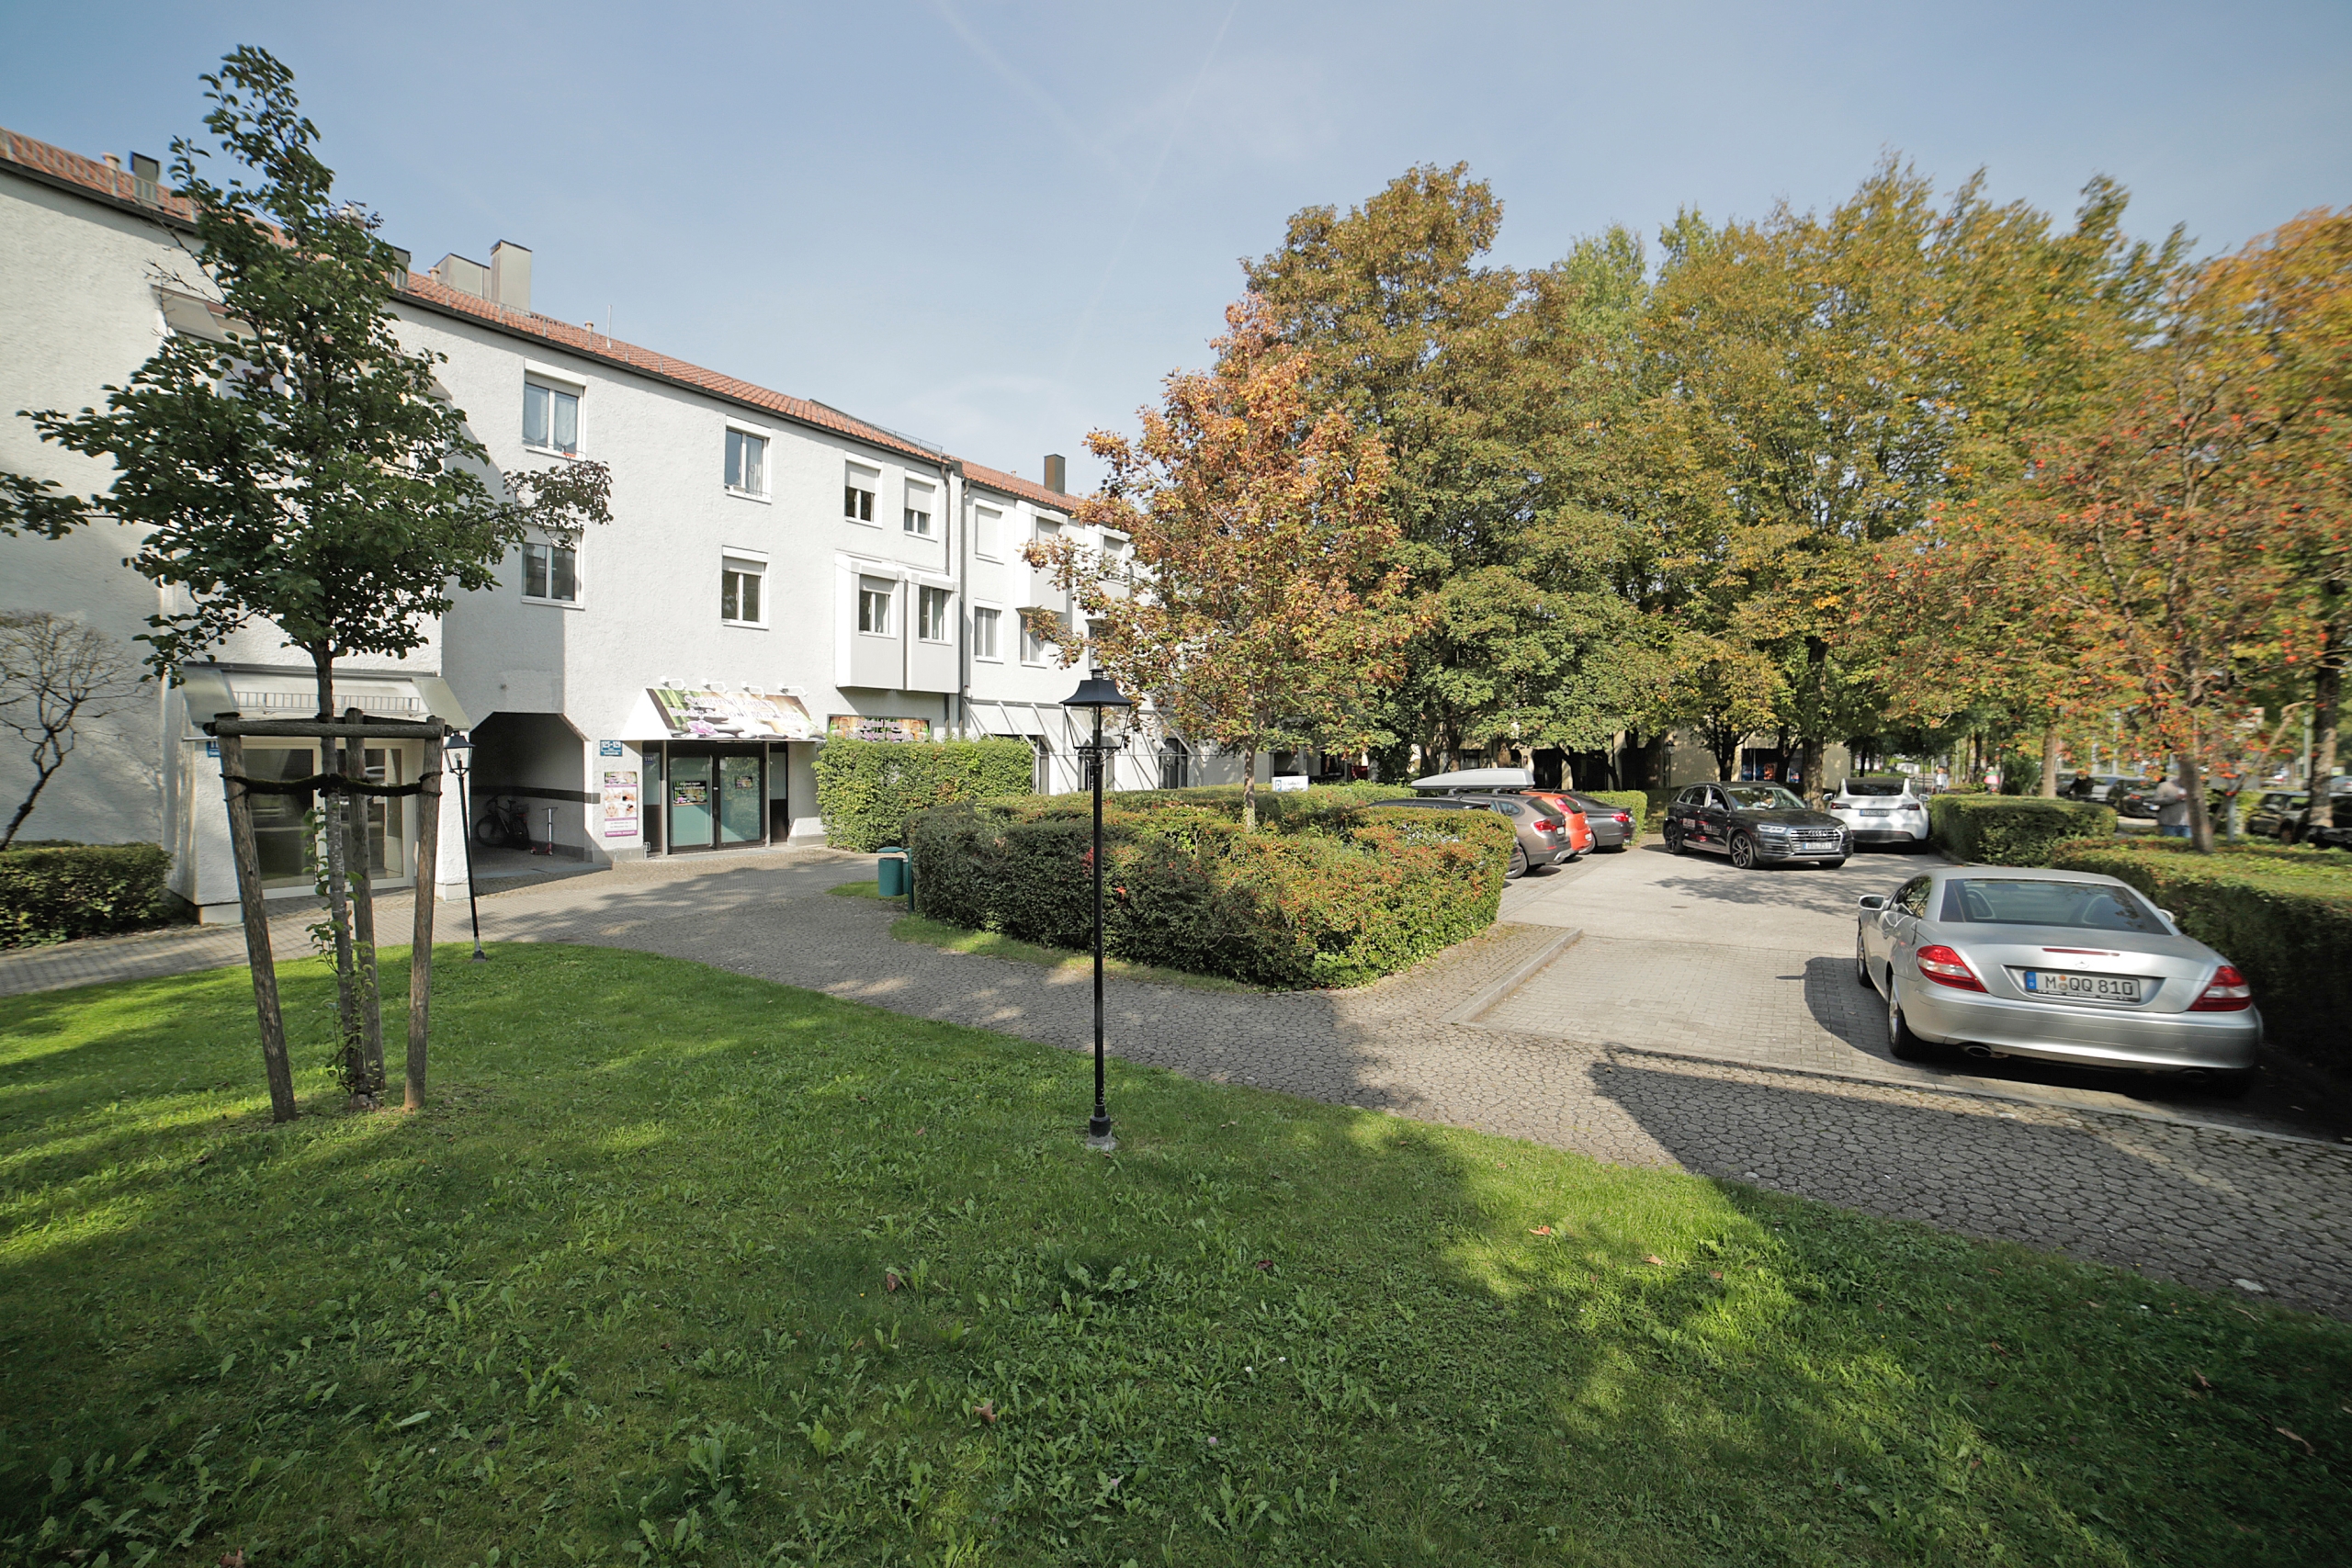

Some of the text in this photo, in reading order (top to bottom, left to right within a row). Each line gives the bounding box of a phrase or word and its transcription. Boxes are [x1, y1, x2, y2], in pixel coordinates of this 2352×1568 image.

[684, 695, 776, 708] Original Japan
[670, 706, 705, 720] Body
[752, 711, 803, 721] Massage
[857, 718, 903, 728] Original Japan
[2045, 976, 2057, 989] M
[2069, 977, 2093, 992] QQ
[2098, 979, 2134, 996] 810
